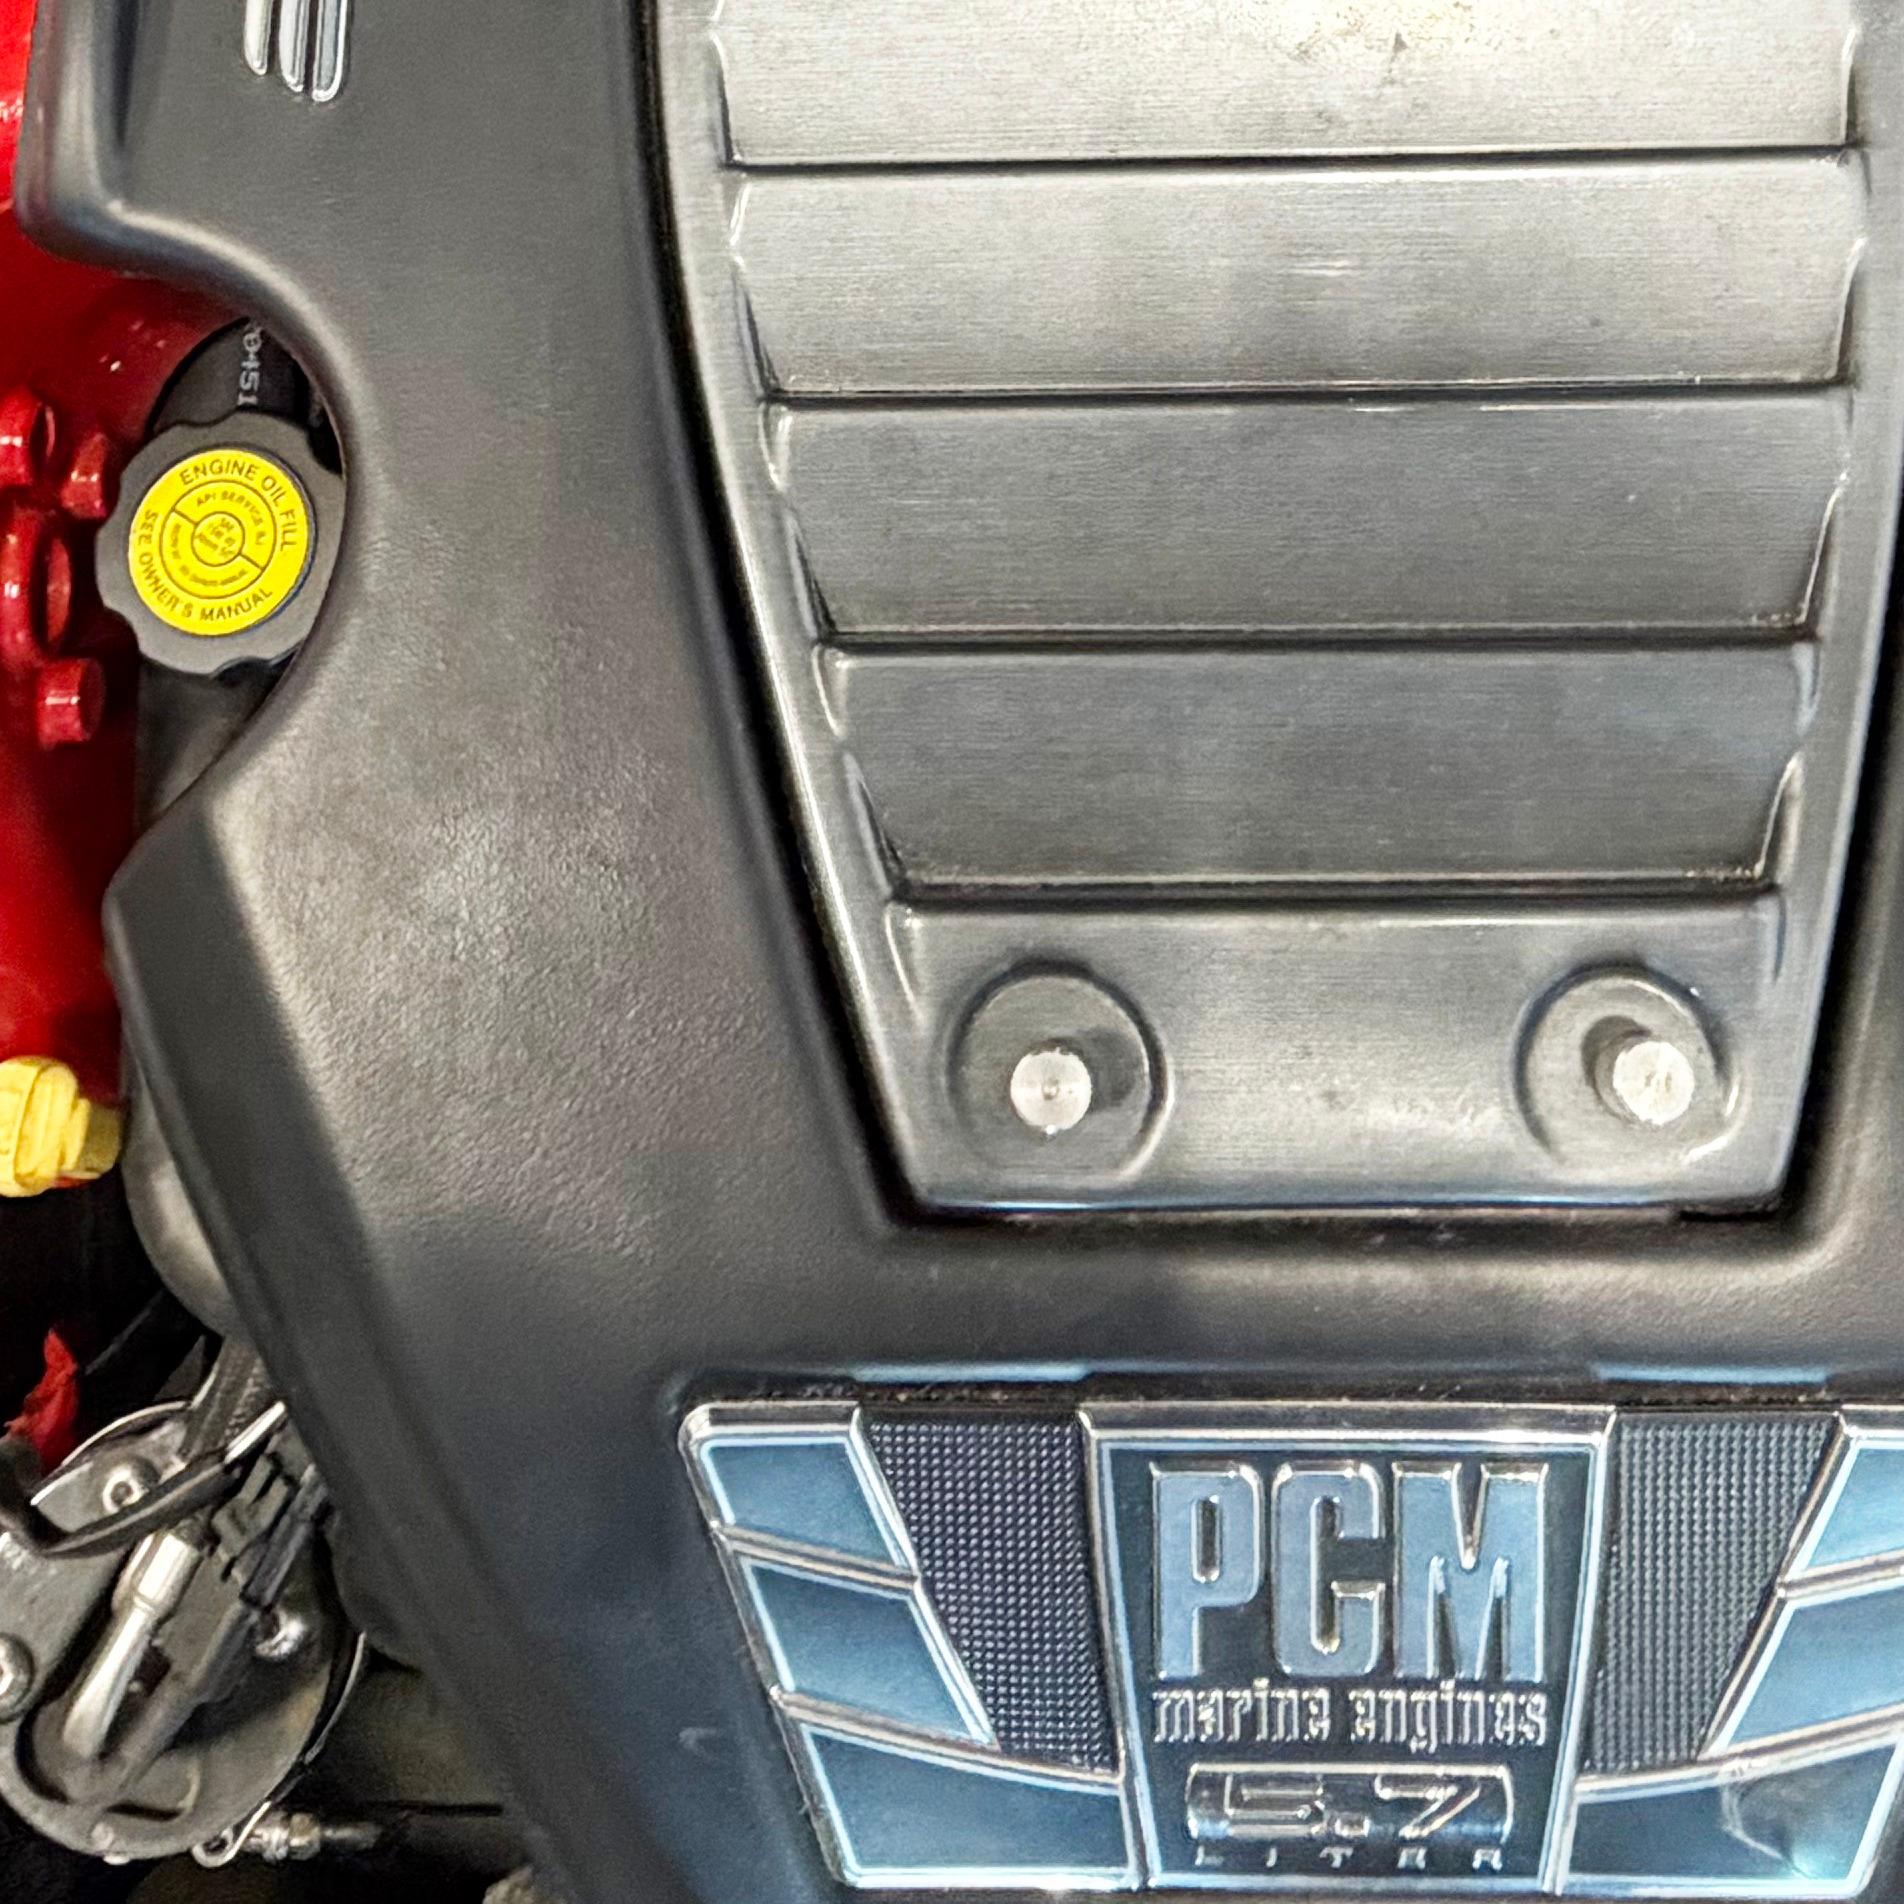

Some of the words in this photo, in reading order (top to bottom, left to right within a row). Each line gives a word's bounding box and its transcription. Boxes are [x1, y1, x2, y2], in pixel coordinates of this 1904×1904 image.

[138, 509, 159, 546] SEE
[180, 458, 261, 485] ENGINE
[261, 476, 286, 507] OIL
[280, 509, 298, 551] FILL
[139, 555, 194, 618] OWNER'S
[200, 587, 273, 622] MANUAL
[1150, 1459, 1550, 1682] PCM
[1152, 1677, 1331, 1744] marine
[1348, 1678, 1548, 1754] engines
[1223, 1768, 1482, 1840] 5.7
